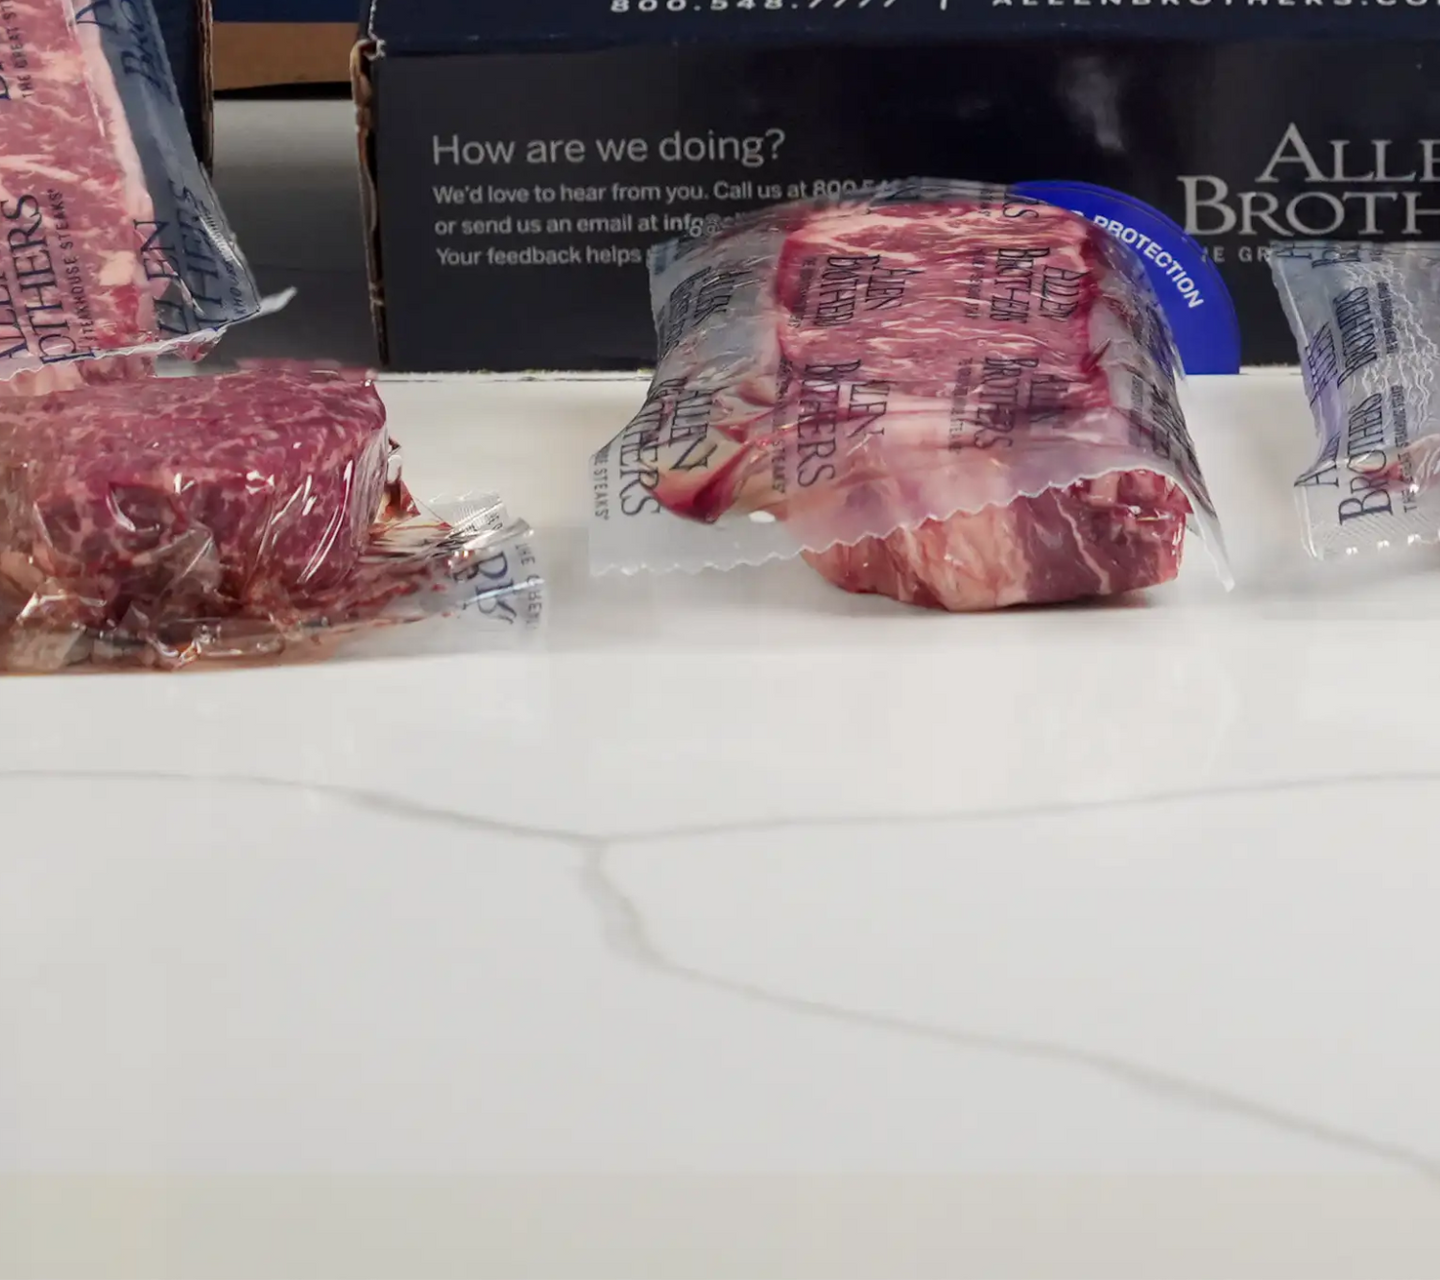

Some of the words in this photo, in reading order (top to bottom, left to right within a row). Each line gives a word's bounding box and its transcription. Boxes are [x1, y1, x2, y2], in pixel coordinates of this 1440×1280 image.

[432, 134, 515, 165] How
[526, 139, 585, 164] are
[596, 137, 648, 163] we
[659, 128, 786, 167] doing?
[432, 184, 483, 205] We'd
[488, 183, 528, 203] love
[533, 185, 556, 203] to
[560, 183, 606, 203] hear
[611, 182, 660, 202] from
[665, 185, 709, 207] you.
[713, 180, 752, 200] Call
[757, 184, 782, 200] us
[787, 181, 808, 199] at
[434, 219, 457, 236] or
[462, 215, 512, 235] send
[516, 219, 541, 235] us
[546, 218, 572, 234] an
[577, 213, 633, 233] email
[637, 215, 659, 232] at
[436, 248, 482, 267] Your
[486, 244, 581, 265] feedback
[586, 243, 642, 270] helps
[1093, 215, 1204, 309] PROTECTION
